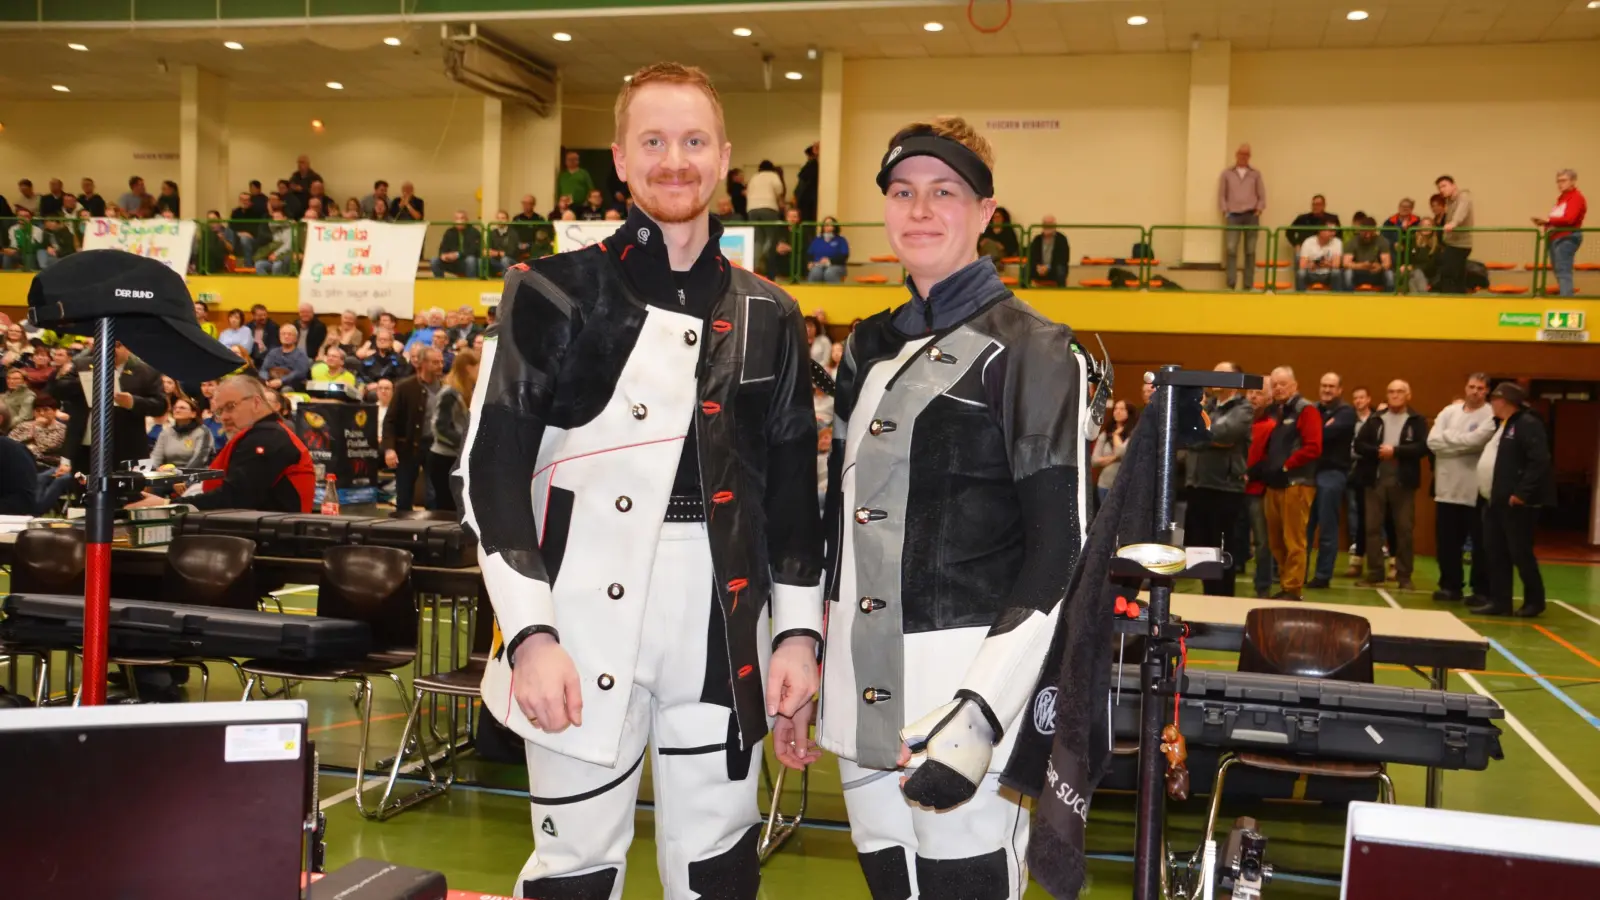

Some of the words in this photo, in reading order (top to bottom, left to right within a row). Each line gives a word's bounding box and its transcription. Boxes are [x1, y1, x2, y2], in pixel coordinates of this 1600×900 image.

[348, 245, 371, 258] und
[311, 263, 335, 283] Gut
[115, 288, 131, 298] DER
[132, 290, 154, 299] BUND
[1500, 313, 1541, 326] Ausgang
